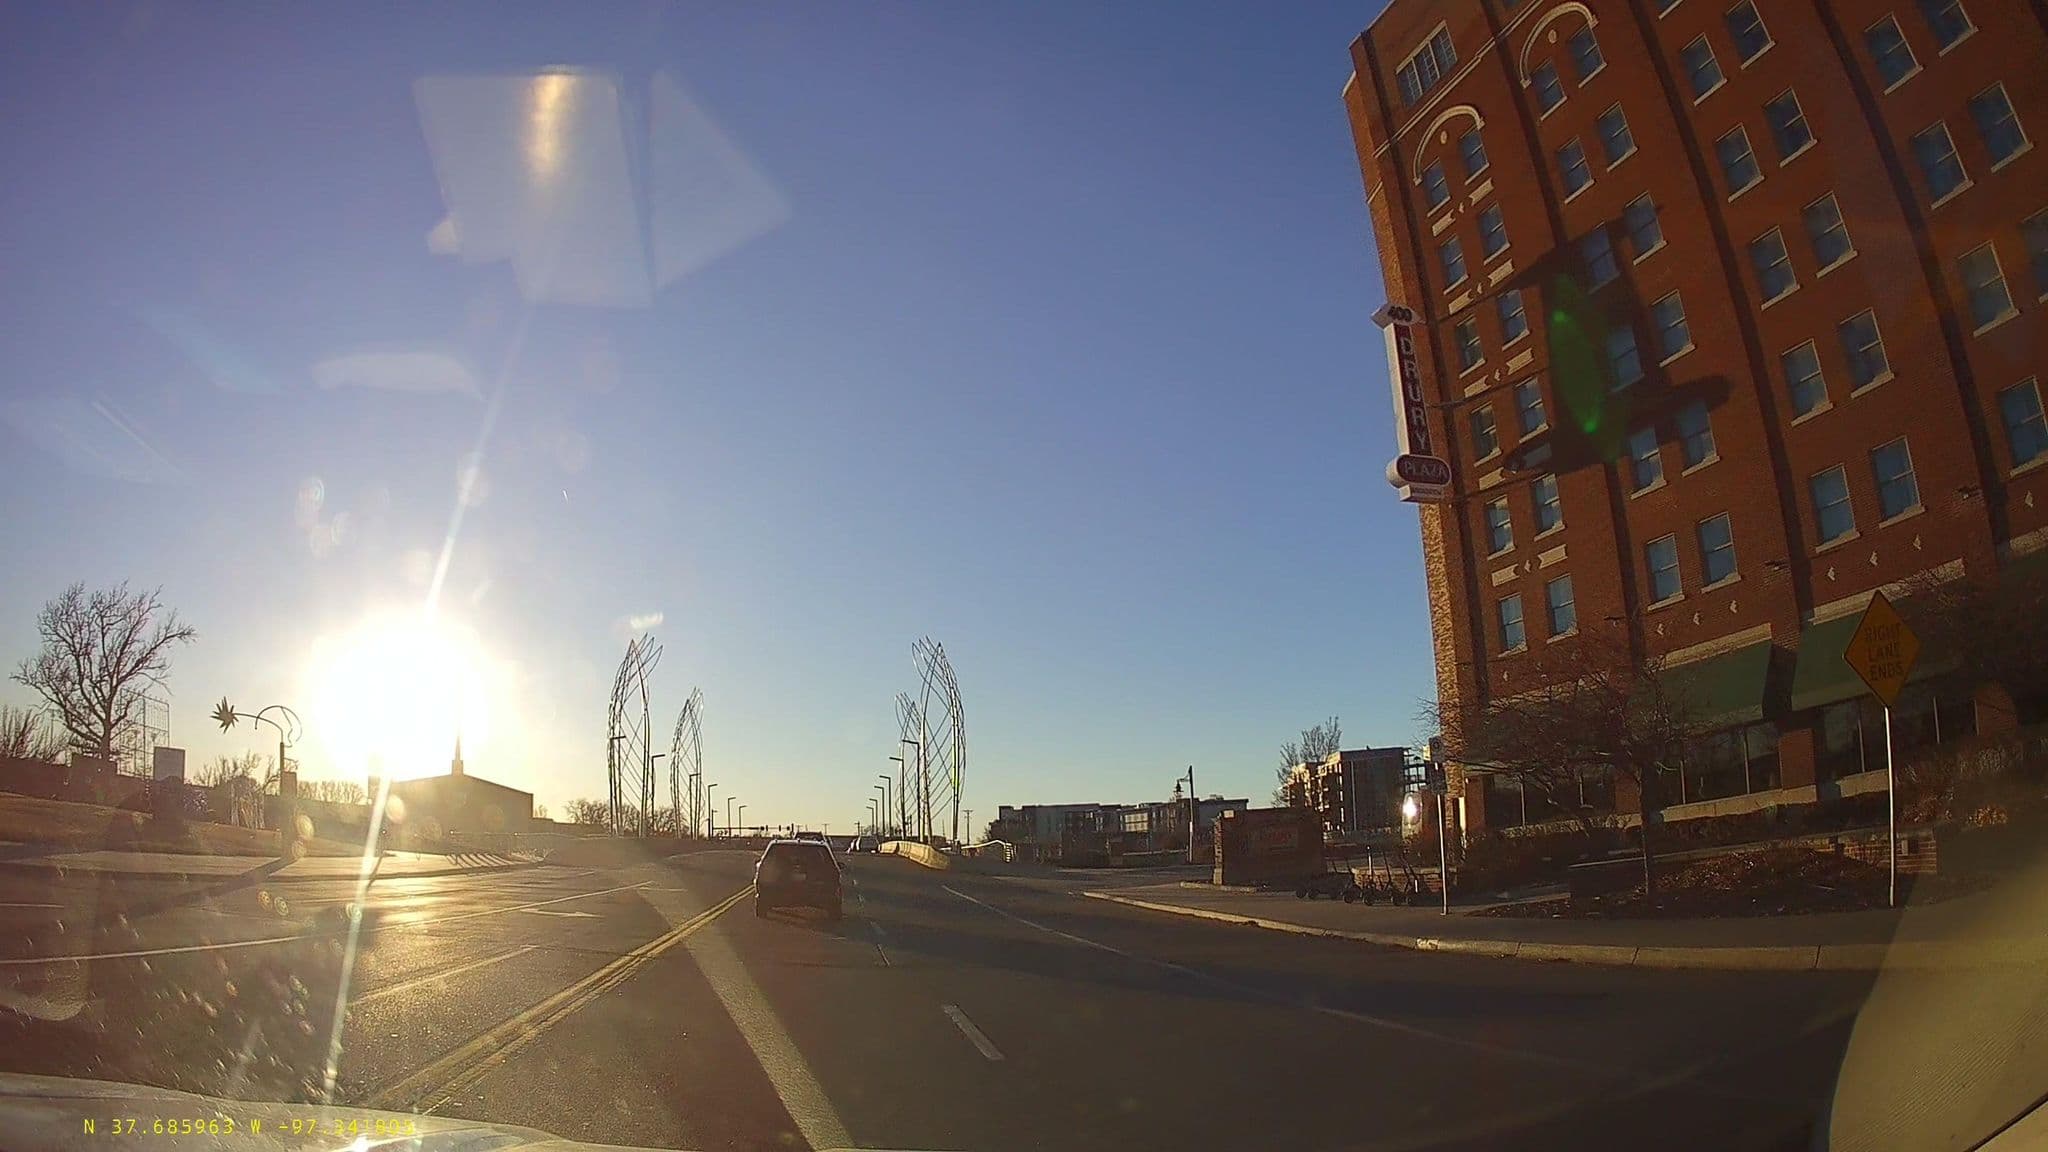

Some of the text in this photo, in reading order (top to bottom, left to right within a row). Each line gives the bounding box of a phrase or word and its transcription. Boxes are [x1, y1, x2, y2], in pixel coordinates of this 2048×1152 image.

[1388, 306, 1412, 322] 400
[1401, 338, 1430, 450] DRURY
[1404, 461, 1448, 479] PLAZA
[1865, 623, 1902, 642] RIGHT
[1868, 641, 1899, 662] LANE
[1869, 662, 1904, 681] ENDS
